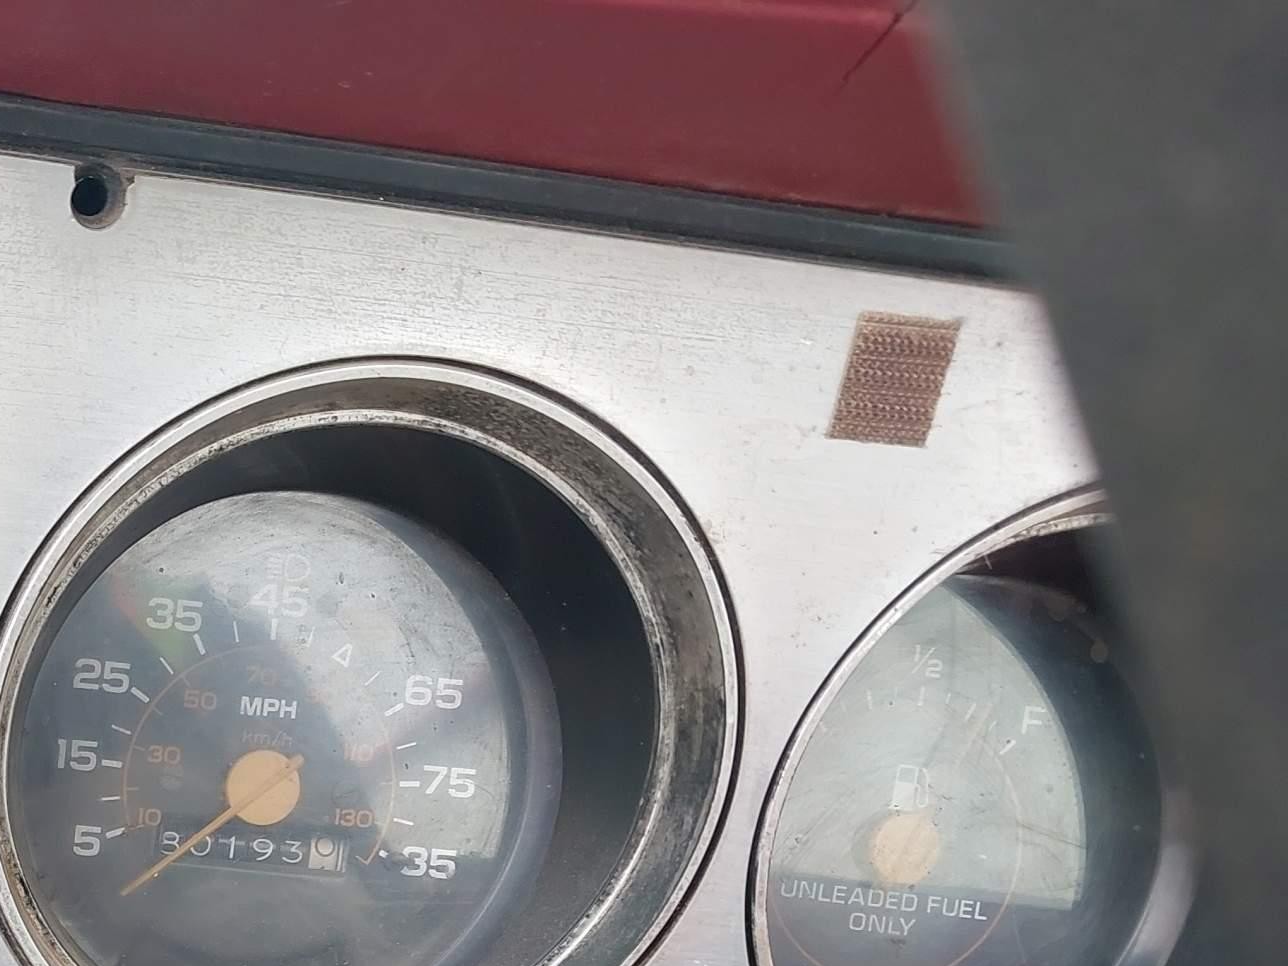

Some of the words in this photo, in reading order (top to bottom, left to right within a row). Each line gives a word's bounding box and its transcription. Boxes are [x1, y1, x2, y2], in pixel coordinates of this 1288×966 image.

[146, 598, 203, 632] 35
[248, 584, 310, 617] 45
[73, 658, 131, 693] 25
[184, 689, 217, 710] 50
[240, 695, 298, 719] MPH
[405, 674, 464, 710] 65
[1022, 705, 1049, 735] F
[57, 739, 99, 772] 15
[147, 745, 181, 764] 30
[424, 765, 477, 799] 75
[137, 808, 162, 827] 10
[334, 808, 374, 828] 130
[73, 825, 103, 857] 5
[780, 879, 918, 912] UNLEADED
[927, 896, 988, 921] FUEL
[849, 912, 916, 936] ONLY
